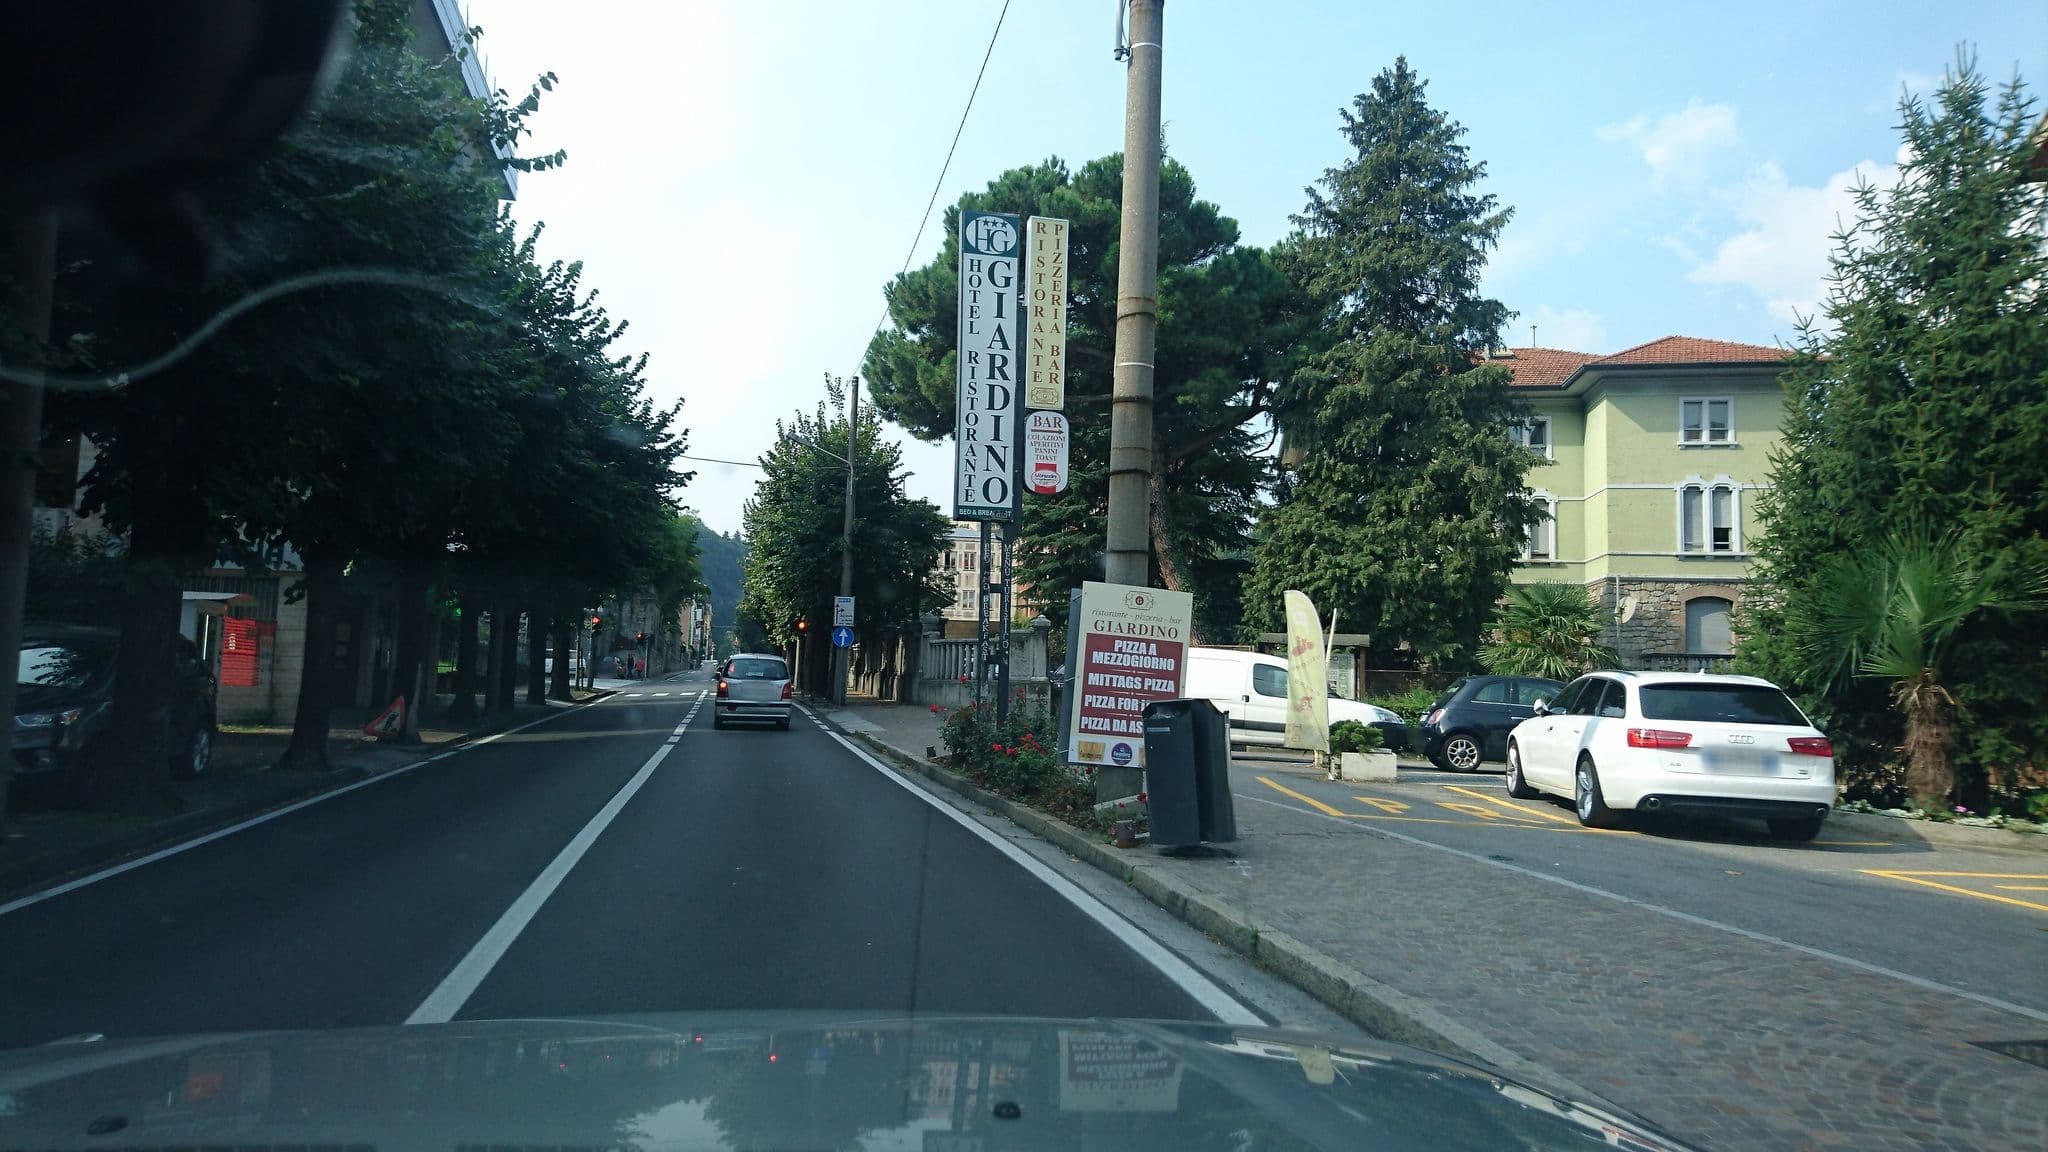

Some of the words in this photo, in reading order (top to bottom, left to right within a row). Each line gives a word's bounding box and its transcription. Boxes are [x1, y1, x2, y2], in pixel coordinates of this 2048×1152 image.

[1050, 224, 1064, 334] PIZZERIA
[967, 259, 982, 335] HOTEL
[1033, 222, 1048, 383] RISTORANTE
[1049, 345, 1061, 384] BAR
[982, 260, 1014, 505] GIARDINO
[964, 350, 980, 503] RISTORANTE
[1033, 415, 1062, 428] BAR
[1027, 434, 1066, 442] COLAZIONI
[1002, 579, 1011, 649] TURISTICO
[1091, 609, 1128, 619] ristorante
[1134, 613, 1163, 623] pizzeria
[1169, 615, 1181, 624] bar
[982, 594, 990, 660] BREAKFAST
[1093, 619, 1179, 640] GIARDINO
[1114, 639, 1148, 654] PIZZA
[1149, 643, 1157, 656] A
[1091, 651, 1175, 671] MEZZOGIORNO
[1087, 672, 1142, 690] MITTAGS
[1143, 678, 1175, 693] PIZZA
[1084, 694, 1116, 710] PIZZA
[1117, 697, 1139, 712] FOR
[1080, 716, 1111, 732] PIZZA
[1112, 719, 1127, 732] DA
